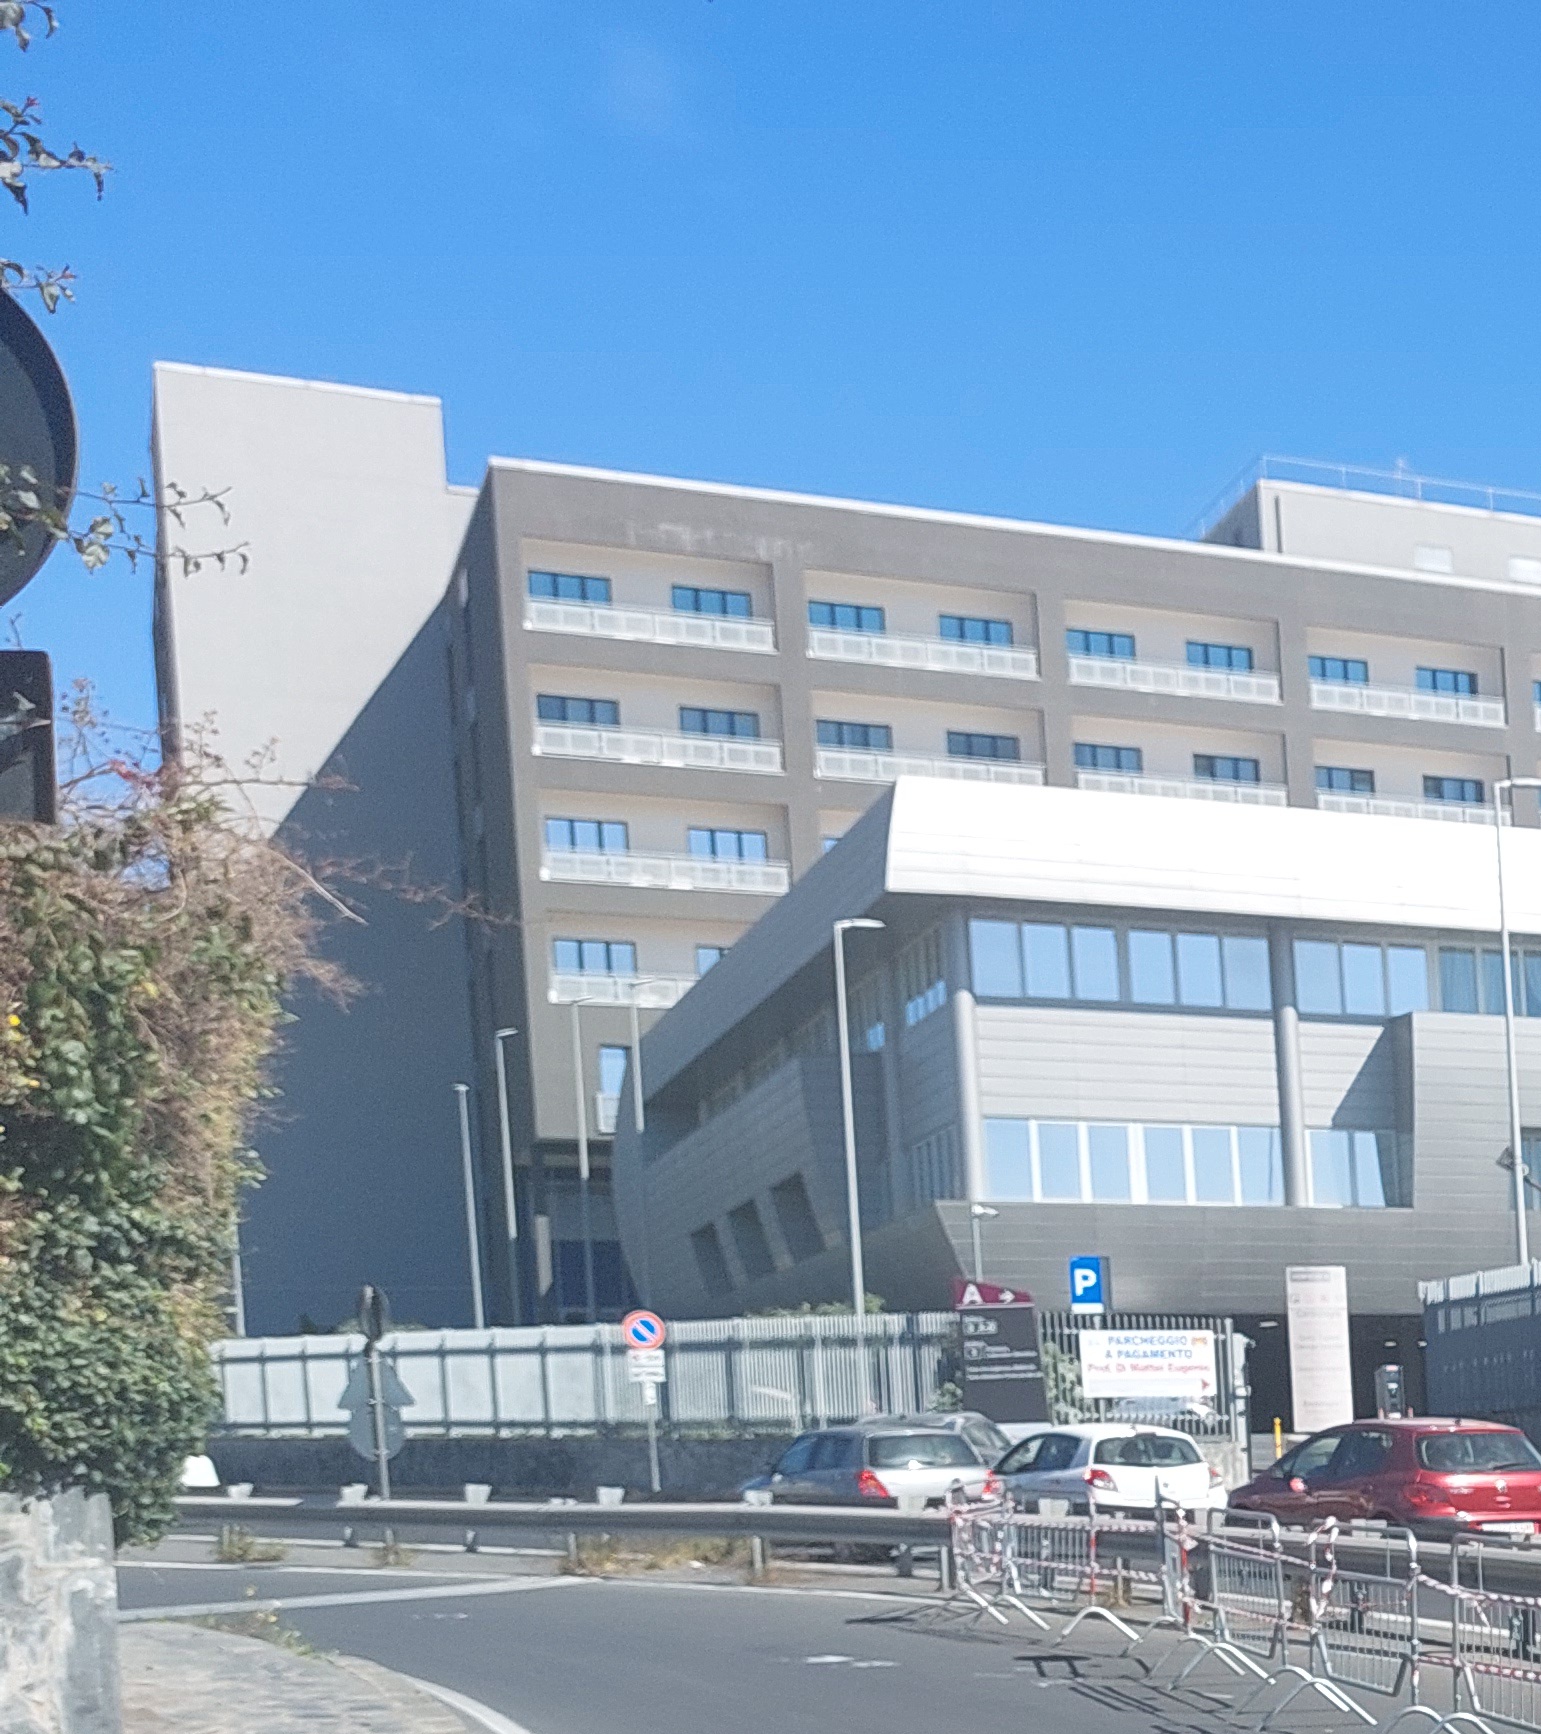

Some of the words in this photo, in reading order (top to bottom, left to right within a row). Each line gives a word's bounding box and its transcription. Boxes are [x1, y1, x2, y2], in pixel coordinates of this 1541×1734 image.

[1074, 1268, 1097, 1297] P
[961, 1283, 984, 1306] A
[1107, 1335, 1188, 1346] PARCHEGGIO
[1117, 1349, 1193, 1359] PAGAMENTO
